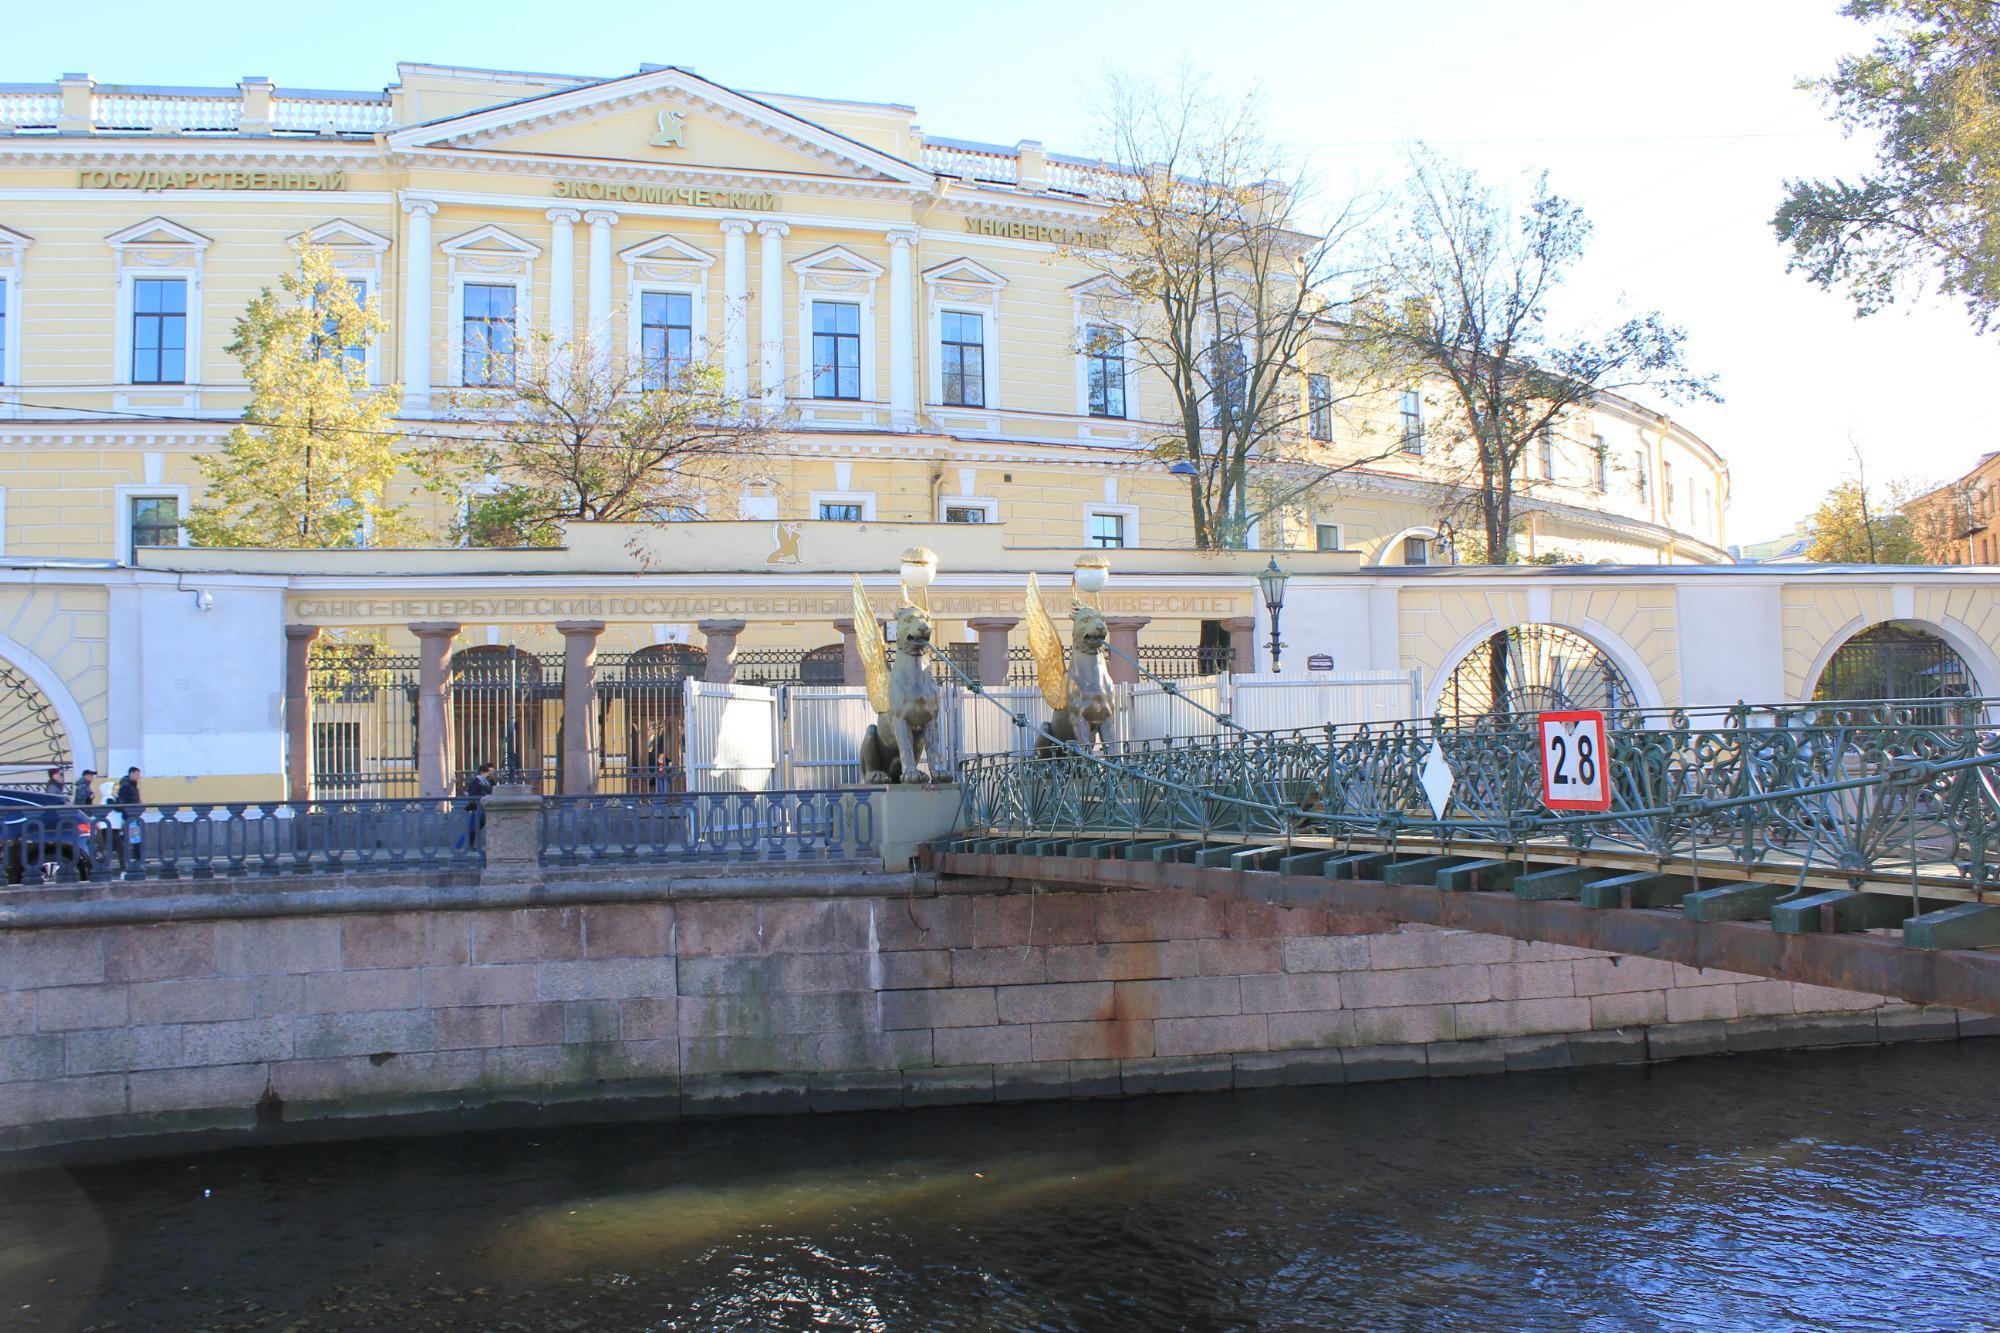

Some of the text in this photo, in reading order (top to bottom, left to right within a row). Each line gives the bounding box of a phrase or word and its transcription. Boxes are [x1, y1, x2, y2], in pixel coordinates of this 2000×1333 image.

[77, 168, 348, 192] ГОСУДАРСТВЕННЫЙ
[553, 178, 780, 211] ЭКОНОМИЧЕСКИЙ
[295, 595, 603, 618] САНКТ-ПЕТЕРБУРГСКИЙ
[608, 593, 856, 617] ГОСУДАРСТВЕННЫЙ
[1551, 734, 1595, 786] 2.8
